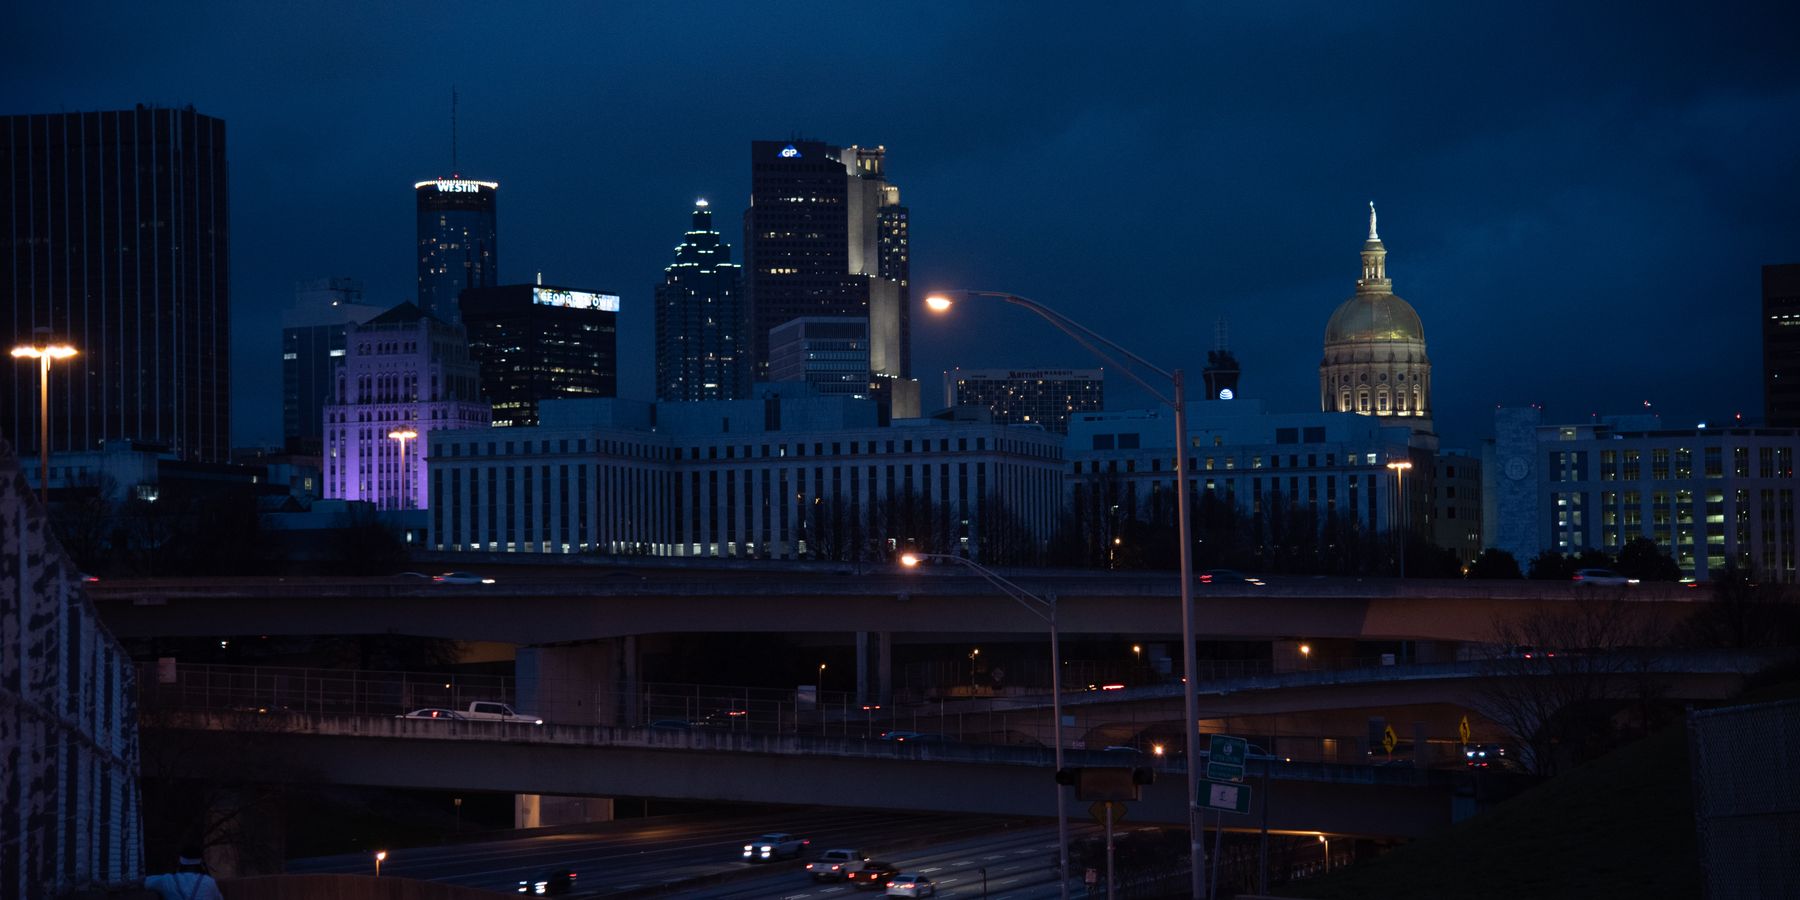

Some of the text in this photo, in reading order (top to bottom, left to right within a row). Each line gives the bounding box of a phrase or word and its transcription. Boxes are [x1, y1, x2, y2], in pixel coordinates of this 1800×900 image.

[781, 148, 798, 158] GP
[436, 182, 479, 193] WESTIN
[1007, 370, 1043, 379] Marriott
